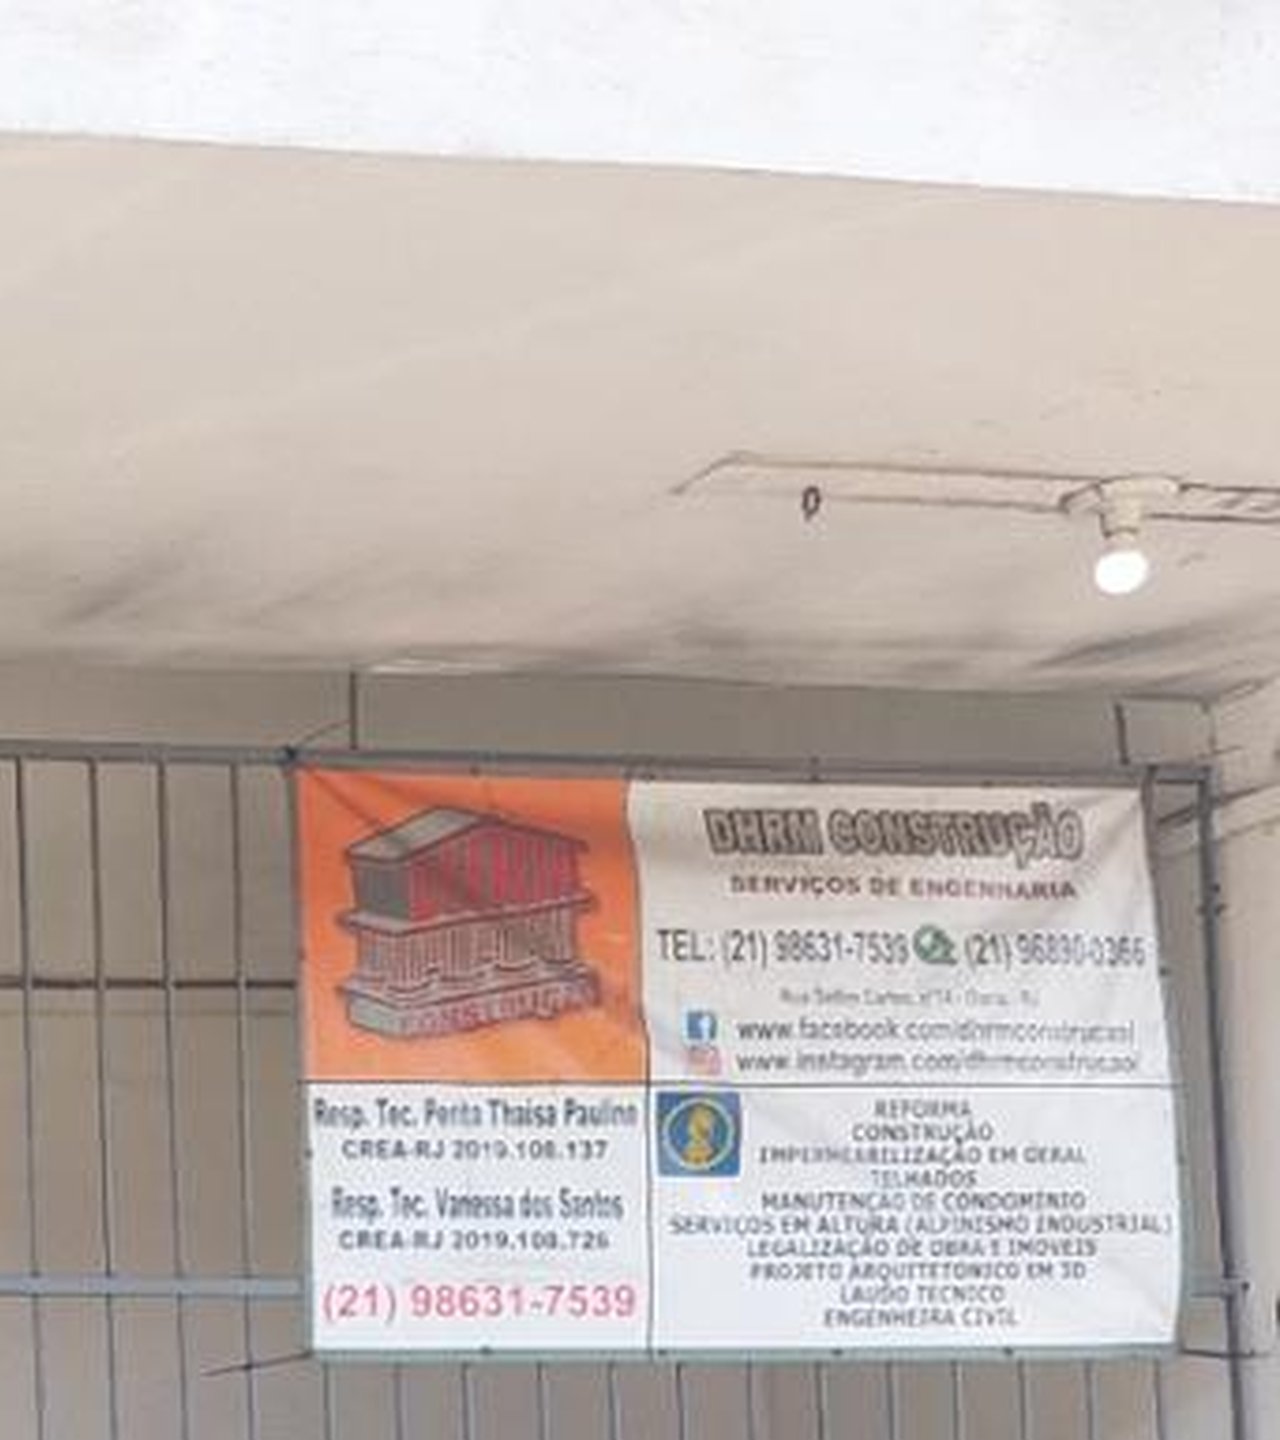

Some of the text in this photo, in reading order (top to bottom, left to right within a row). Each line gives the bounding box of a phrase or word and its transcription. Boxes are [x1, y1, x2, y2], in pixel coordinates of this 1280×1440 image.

[703, 801, 1084, 870] DHRM CONSTRUÇÃO
[730, 875, 1078, 900] SERVIÇOS DE ENGENHARIA
[656, 929, 910, 968] TEL: (21) 98631-7539
[964, 933, 1012, 973] (21)
[314, 1097, 369, 1131] Resp.
[375, 1097, 418, 1127] Tec.
[563, 1097, 638, 1128] Paulino
[874, 1099, 972, 1119] REFORMA
[852, 1120, 994, 1145] CONSTRUÇÃO
[341, 1139, 445, 1160] CREA-RJ
[989, 1147, 1018, 1163] EM
[1023, 1147, 1087, 1164] GERAL
[870, 1169, 978, 1188] TELHADOS
[331, 1186, 384, 1224] Resp.
[435, 1187, 515, 1220] Vanessa
[519, 1188, 553, 1219] dos
[558, 1187, 625, 1221] Santos
[911, 1191, 936, 1211] DE
[669, 1215, 776, 1238] SERVIÇOS
[780, 1216, 810, 1235] EM
[816, 1216, 899, 1236] ALTURA
[746, 1236, 889, 1260] LEGALIZAÇÃO
[895, 1239, 923, 1257] DE
[930, 1239, 986, 1257] OBRA
[749, 1263, 843, 1282] PROJETO
[1026, 1261, 1055, 1279] EM
[323, 1284, 636, 1324] (21) 98631-7539
[839, 1285, 910, 1304] LAUDO
[823, 1307, 1019, 1328] ENGENHEIRA CIVIL
